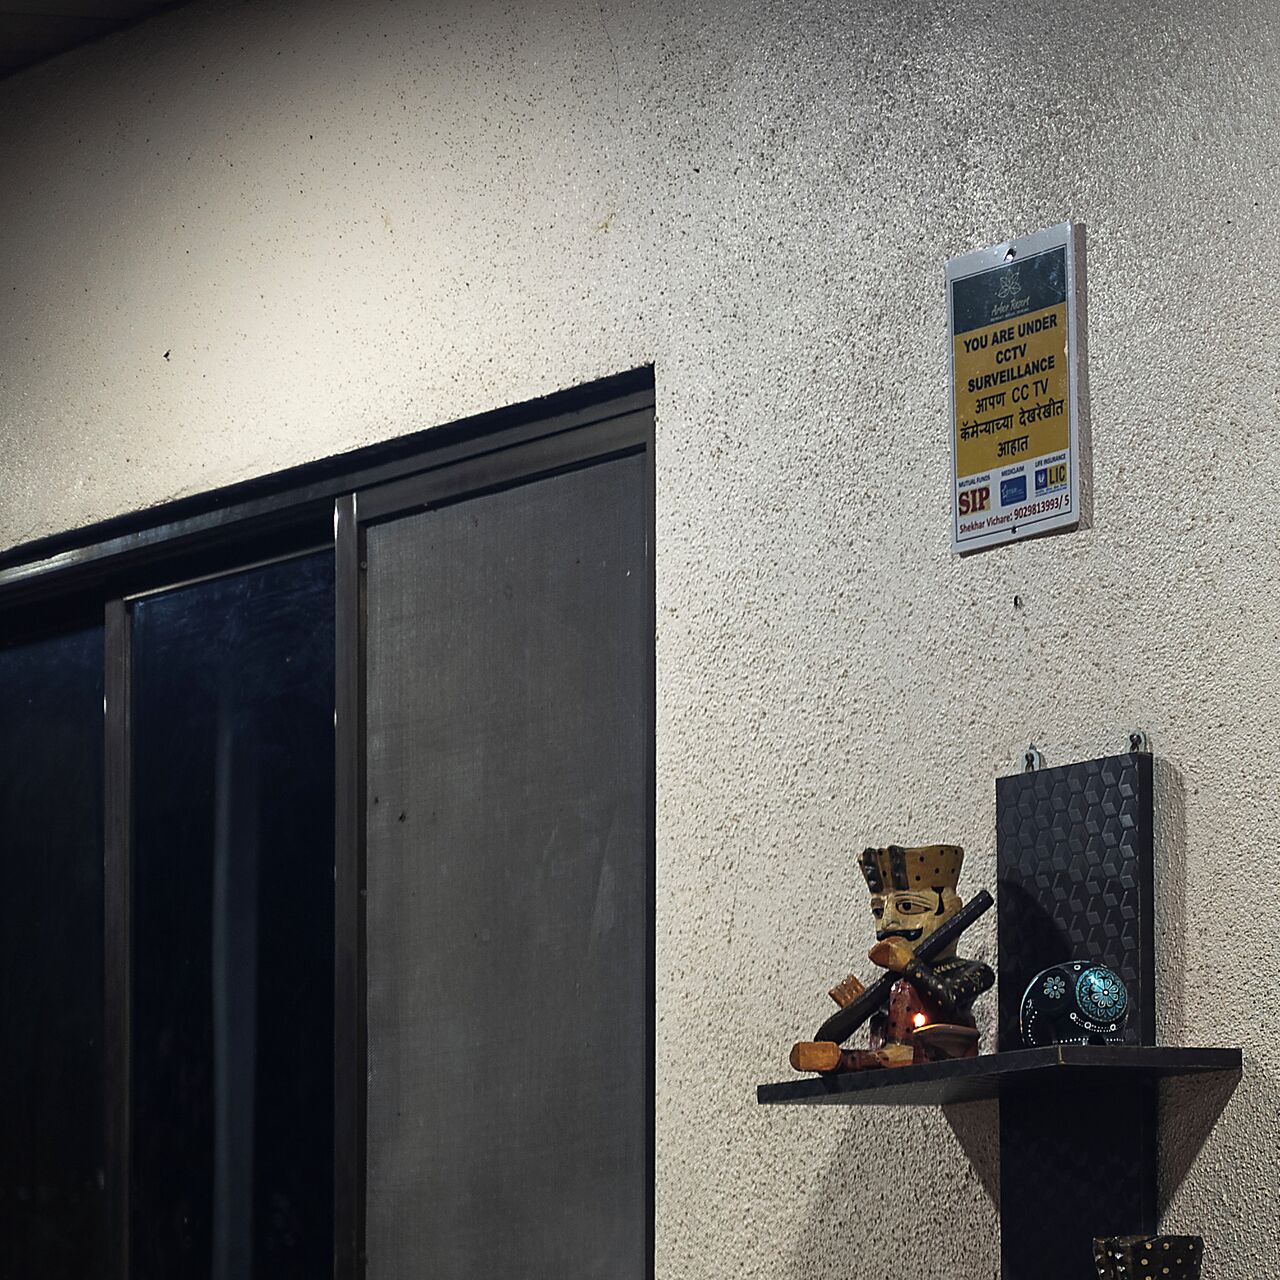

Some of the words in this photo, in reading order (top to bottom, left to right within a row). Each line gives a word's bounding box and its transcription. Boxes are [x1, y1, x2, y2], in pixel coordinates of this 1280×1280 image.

[964, 334, 988, 353] YOU
[991, 327, 1015, 346] ARE
[1018, 313, 1057, 338] UNDER
[996, 343, 1026, 364] CCTV
[968, 355, 1055, 393] SURVEILLANCE
[1012, 384, 1029, 403] CC
[1033, 378, 1049, 397] TV
[975, 392, 1006, 414] आपण
[1019, 397, 1065, 427] देखरेखीत
[997, 435, 1029, 457] आहात
[1001, 466, 1024, 476] MEDICLAIM
[1035, 460, 1043, 468] LIFE
[1043, 453, 1066, 465] INSURANCE
[958, 478, 976, 488] MUTUAL
[976, 474, 991, 484] FUNDS
[1049, 466, 1065, 485] LIC
[958, 486, 991, 515] SIP
[959, 520, 985, 534] Shekhar
